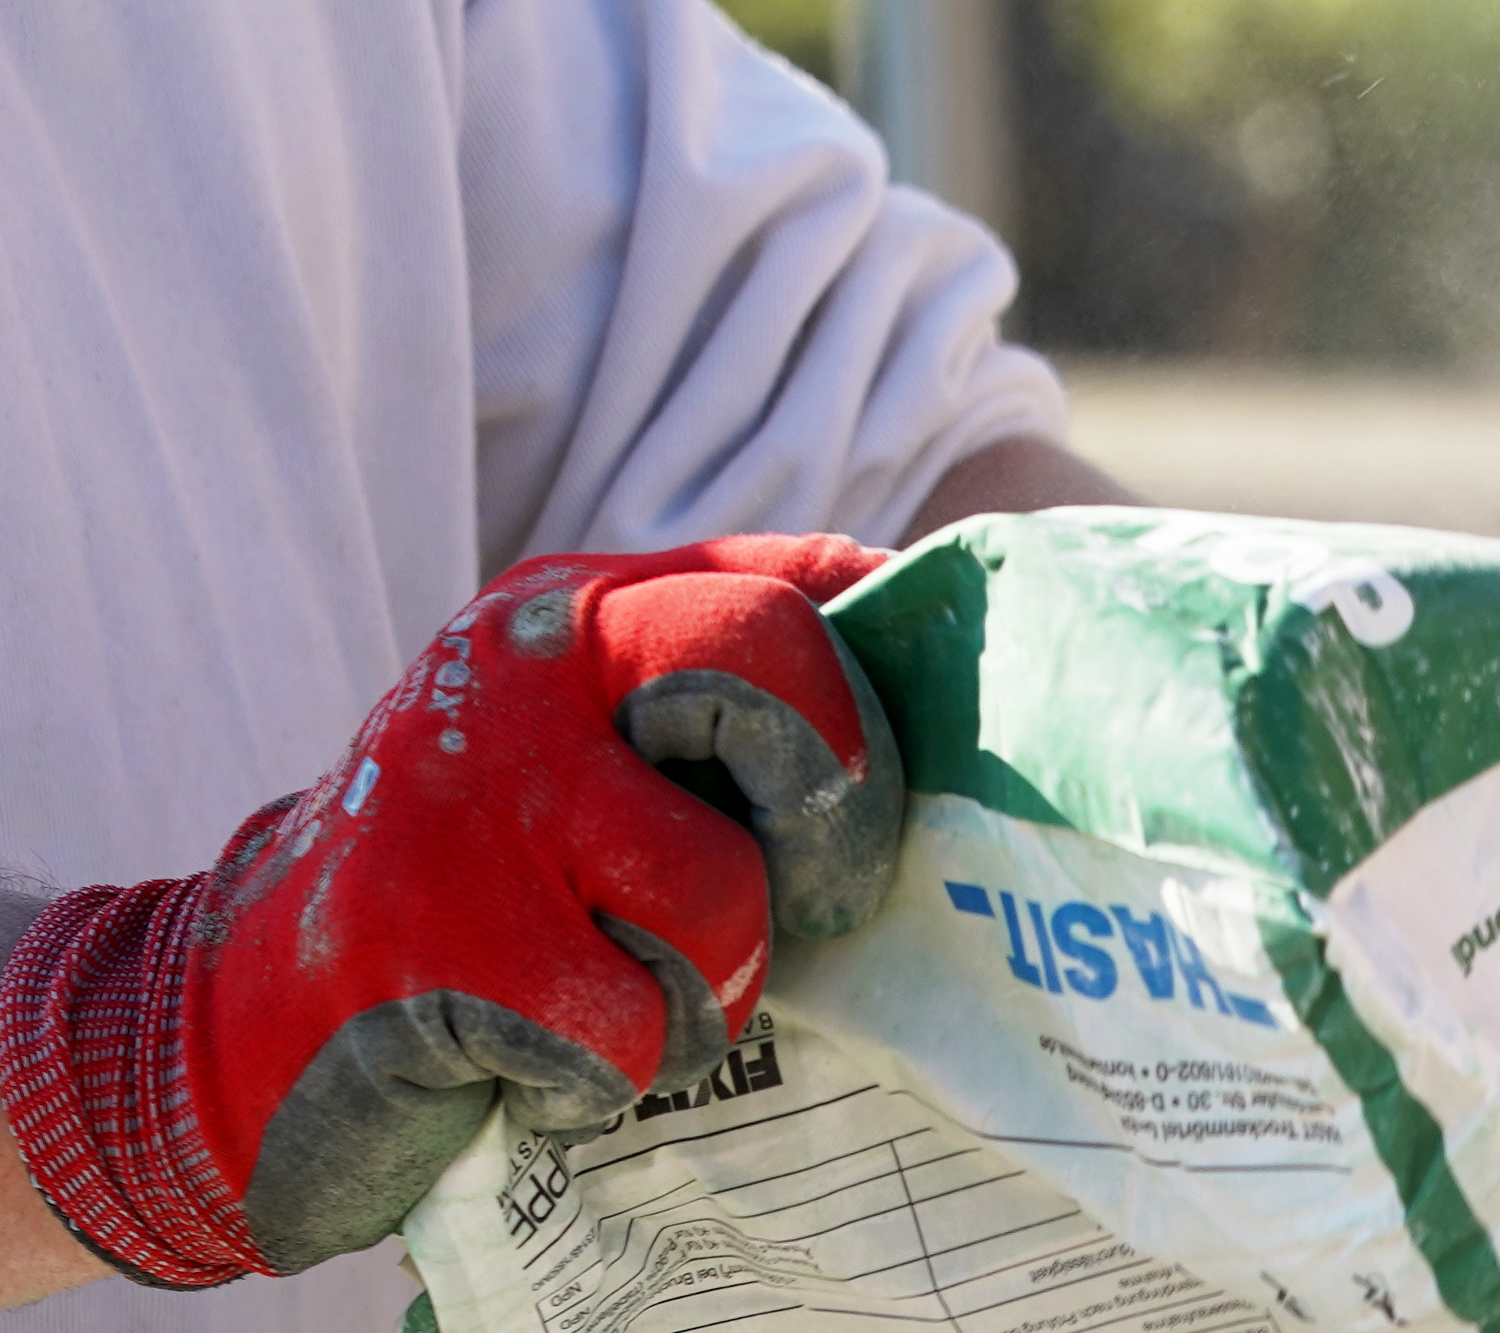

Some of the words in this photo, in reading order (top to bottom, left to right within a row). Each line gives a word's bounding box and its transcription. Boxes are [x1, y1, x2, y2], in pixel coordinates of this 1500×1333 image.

[998, 890, 1236, 1014] HASIT
[1184, 1092, 1214, 1112] 30
[550, 1281, 583, 1308] NPD
